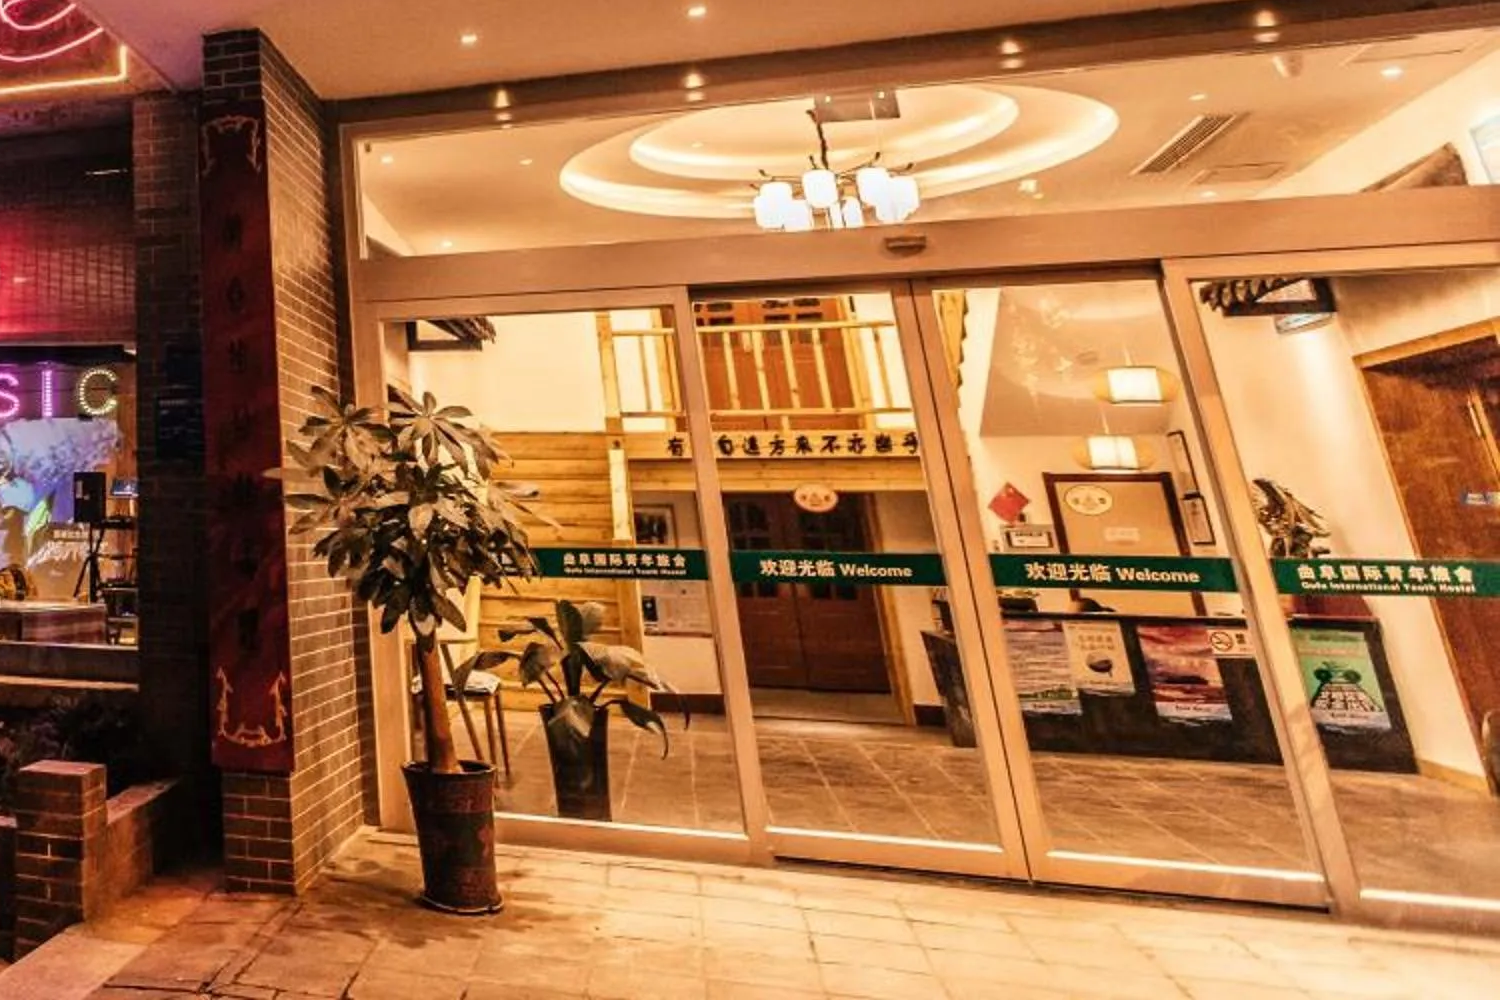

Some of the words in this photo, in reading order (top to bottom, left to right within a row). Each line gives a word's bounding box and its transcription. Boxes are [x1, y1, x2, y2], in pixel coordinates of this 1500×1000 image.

[760, 559, 836, 577] 欢迎光临
[840, 563, 913, 578] Welcome
[1025, 562, 1112, 583] 欢迎光临
[1115, 566, 1200, 584] Welcome
